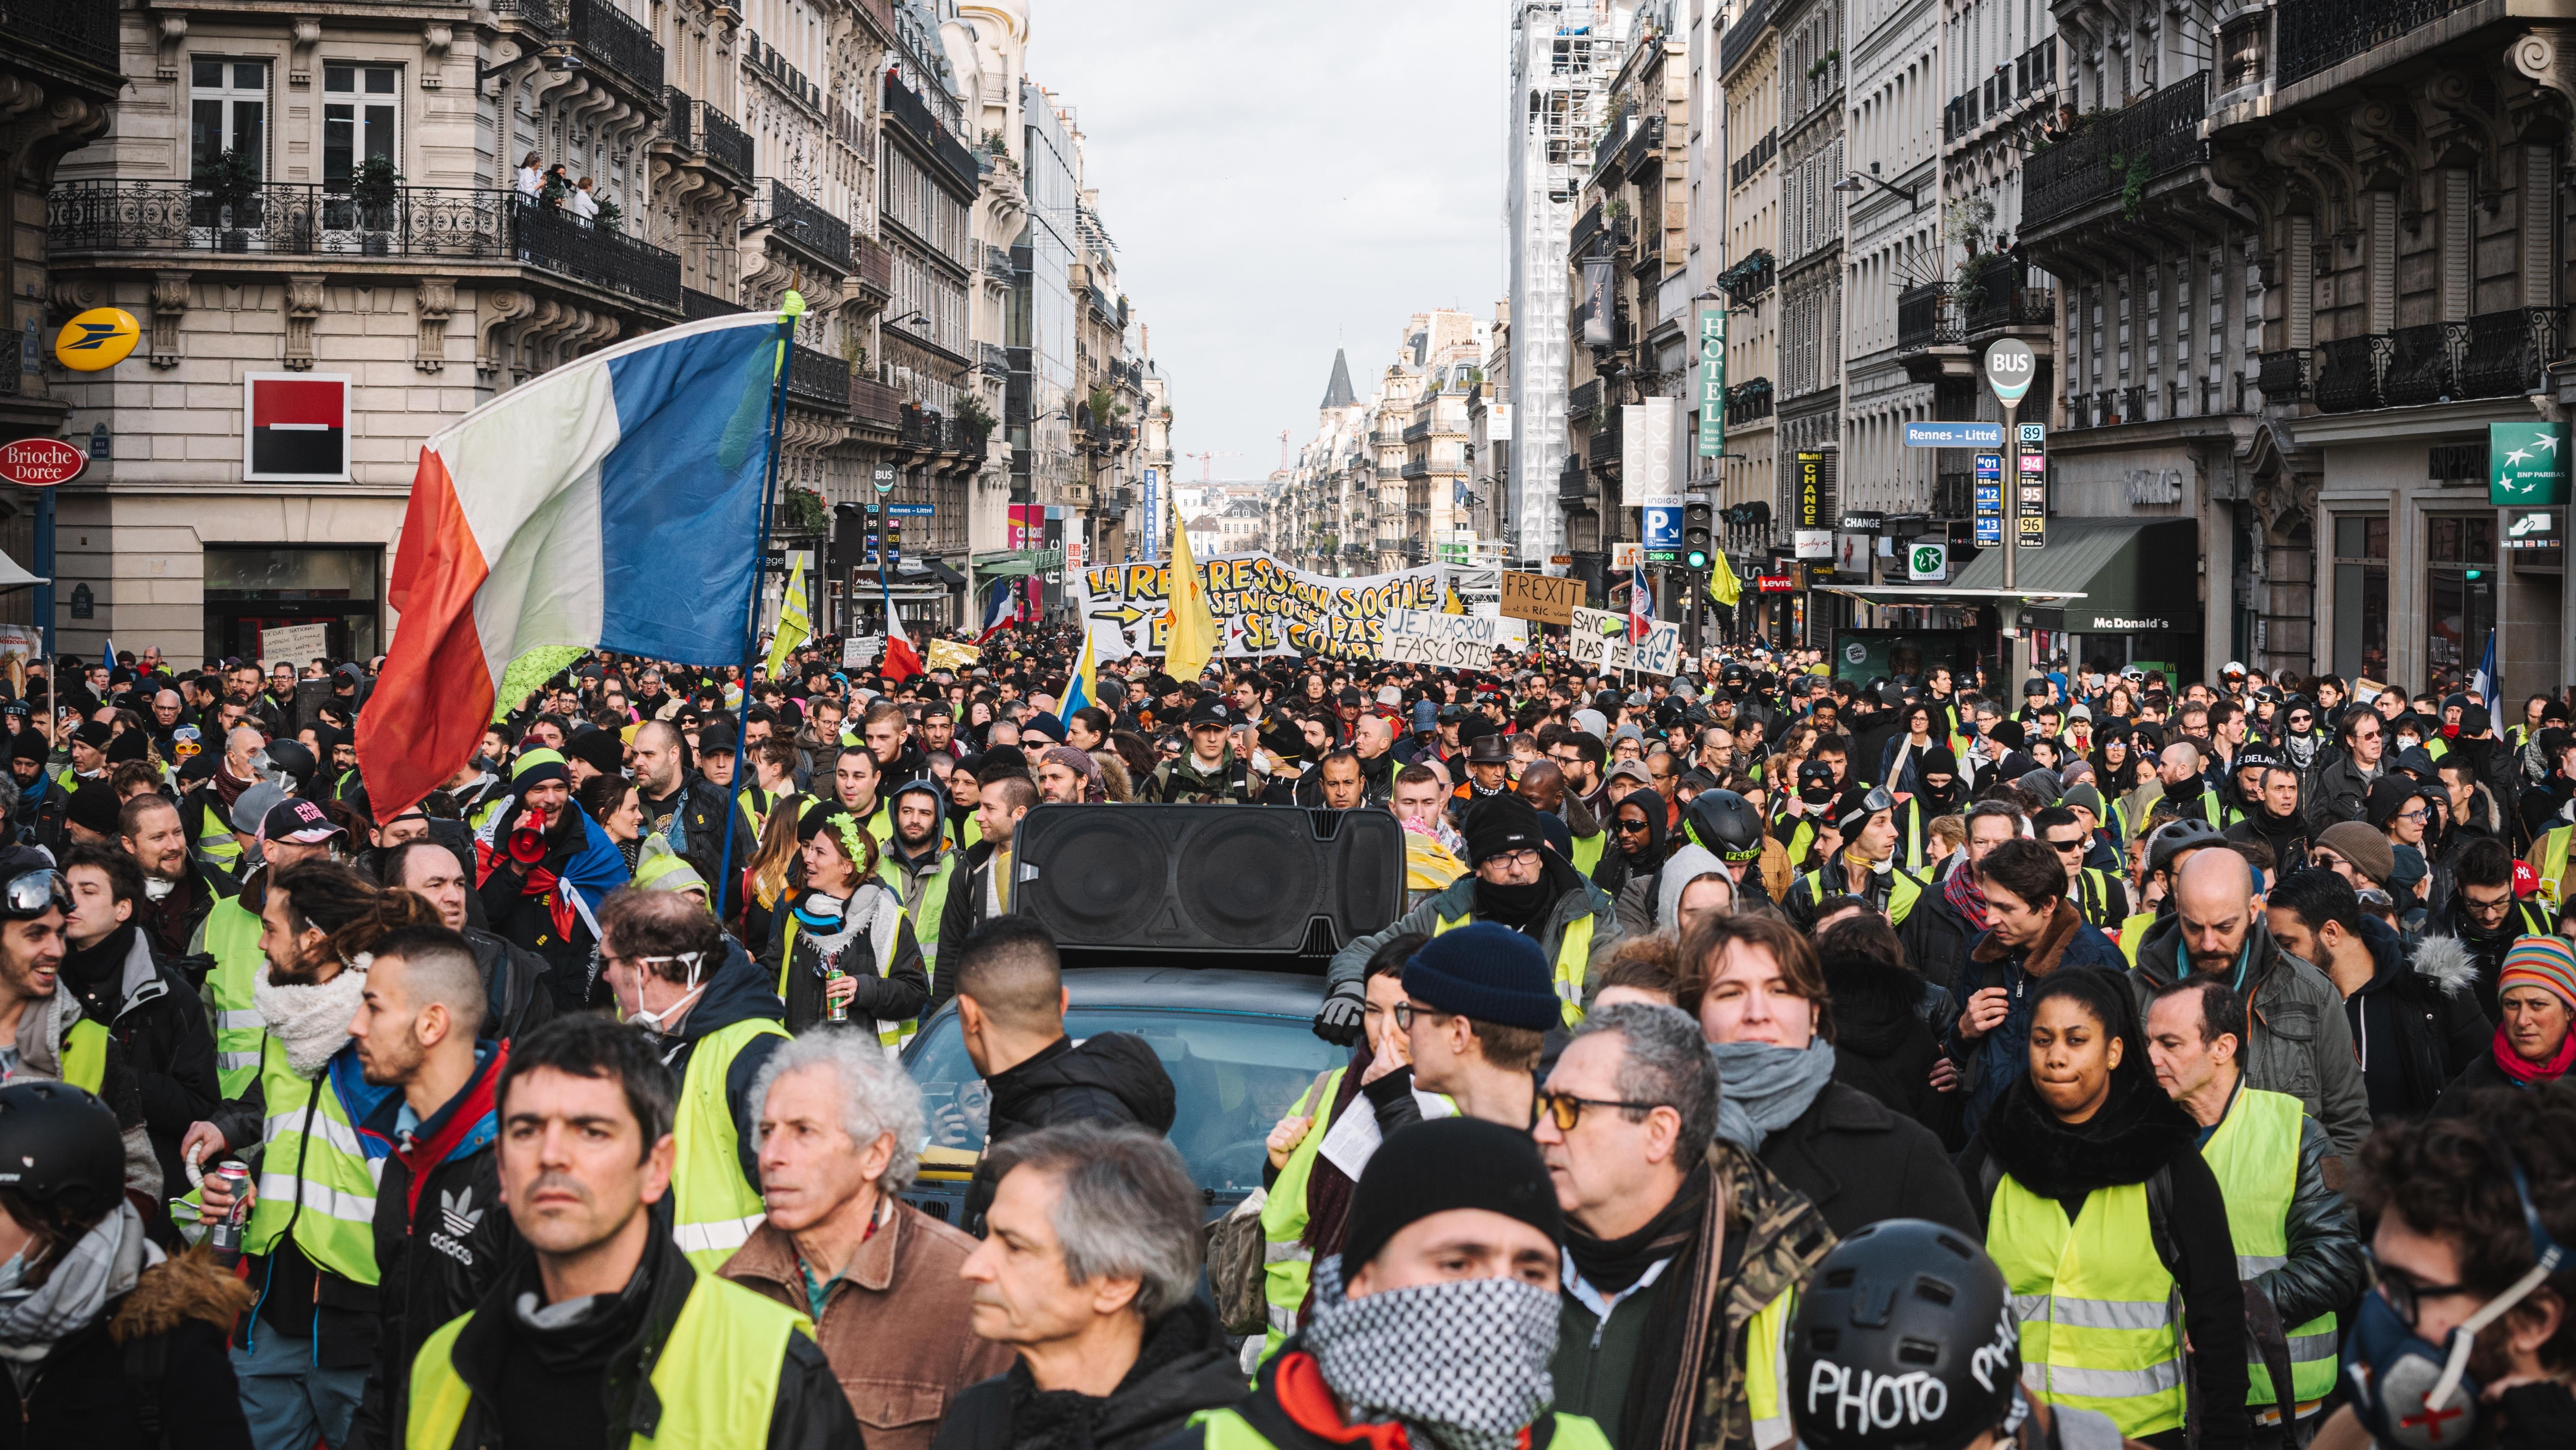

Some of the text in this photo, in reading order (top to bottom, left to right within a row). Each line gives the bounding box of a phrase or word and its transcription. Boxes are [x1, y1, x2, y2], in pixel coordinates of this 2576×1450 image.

[1993, 353, 2028, 372] BUS
[1704, 318, 1725, 422] HOTEL
[1910, 429, 1952, 440] Rennes
[1966, 429, 1997, 441] Littré
[2024, 428, 2040, 439] 89
[8, 446, 72, 464] Brioche
[1978, 457, 1996, 468] N01
[2023, 457, 2041, 471] 94
[16, 463, 62, 479] Dorée
[875, 470, 893, 480] BUS
[1804, 464, 1816, 525] CHANGE
[1978, 488, 1997, 499] N12
[2023, 488, 2041, 501] 95
[1648, 510, 1669, 538] P
[1845, 517, 1881, 529] CHANGE
[1978, 519, 1997, 529] N13
[2022, 519, 2039, 530] 96
[1016, 527, 1043, 538] CAQUEZ
[1799, 538, 1820, 551] Derhy
[856, 577, 877, 586] Melvita
[1086, 566, 1122, 598] LA
[1337, 575, 1437, 620] SOCIALE
[1506, 574, 1582, 606] FREXIT
[1522, 605, 1528, 613] le
[1210, 591, 1238, 618] SE
[1328, 615, 1385, 644] PAS
[1573, 610, 1607, 636] SANS
[265, 629, 284, 637] DÉBAT
[1241, 612, 1280, 652] SE
[1427, 614, 1495, 642] MACRON
[264, 638, 290, 647] CAMPAGNE
[266, 647, 291, 655] MACRON
[1393, 637, 1492, 669] FASCISTES
[1576, 639, 1603, 659] PAS
[1612, 646, 1628, 663] DE
[1728, 848, 1761, 860] PRESSE
[430, 1231, 473, 1266] adidas
[1807, 1359, 1948, 1435] PHOTO
